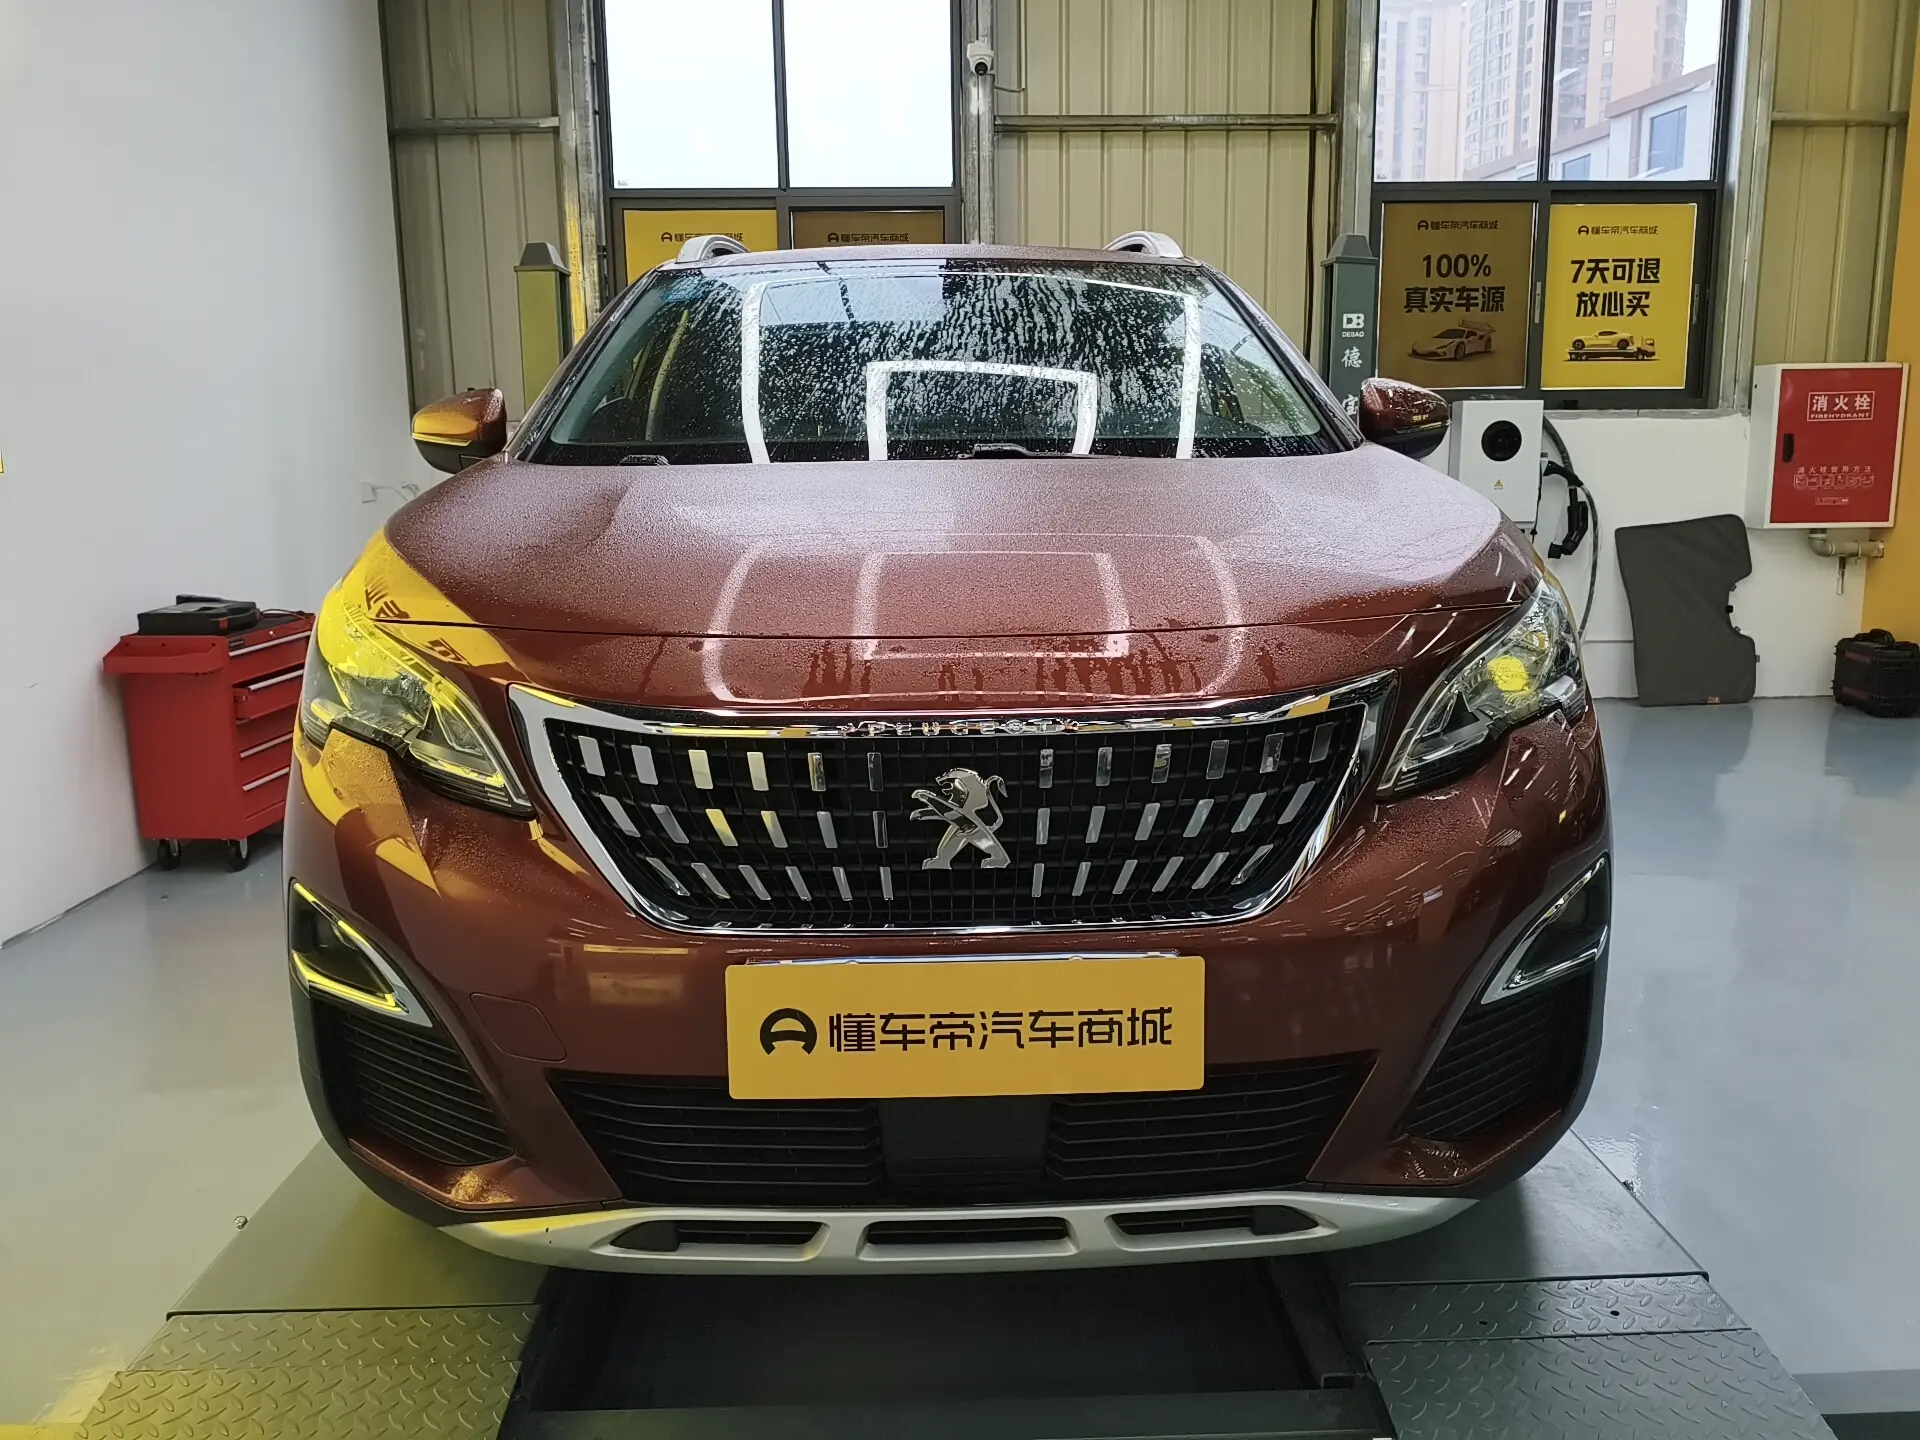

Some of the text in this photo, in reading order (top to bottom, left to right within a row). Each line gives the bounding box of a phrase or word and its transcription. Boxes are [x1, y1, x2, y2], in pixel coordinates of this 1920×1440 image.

[1422, 253, 1492, 278] 100%
[1570, 257, 1661, 284] 7天可退
[1404, 285, 1506, 313] 真实车源
[1575, 291, 1651, 317] 放心买
[1812, 394, 1871, 412] 消火栓
[867, 719, 1053, 737] PEUGEOT
[828, 1006, 1173, 1053] 懂车帝汽车商城
